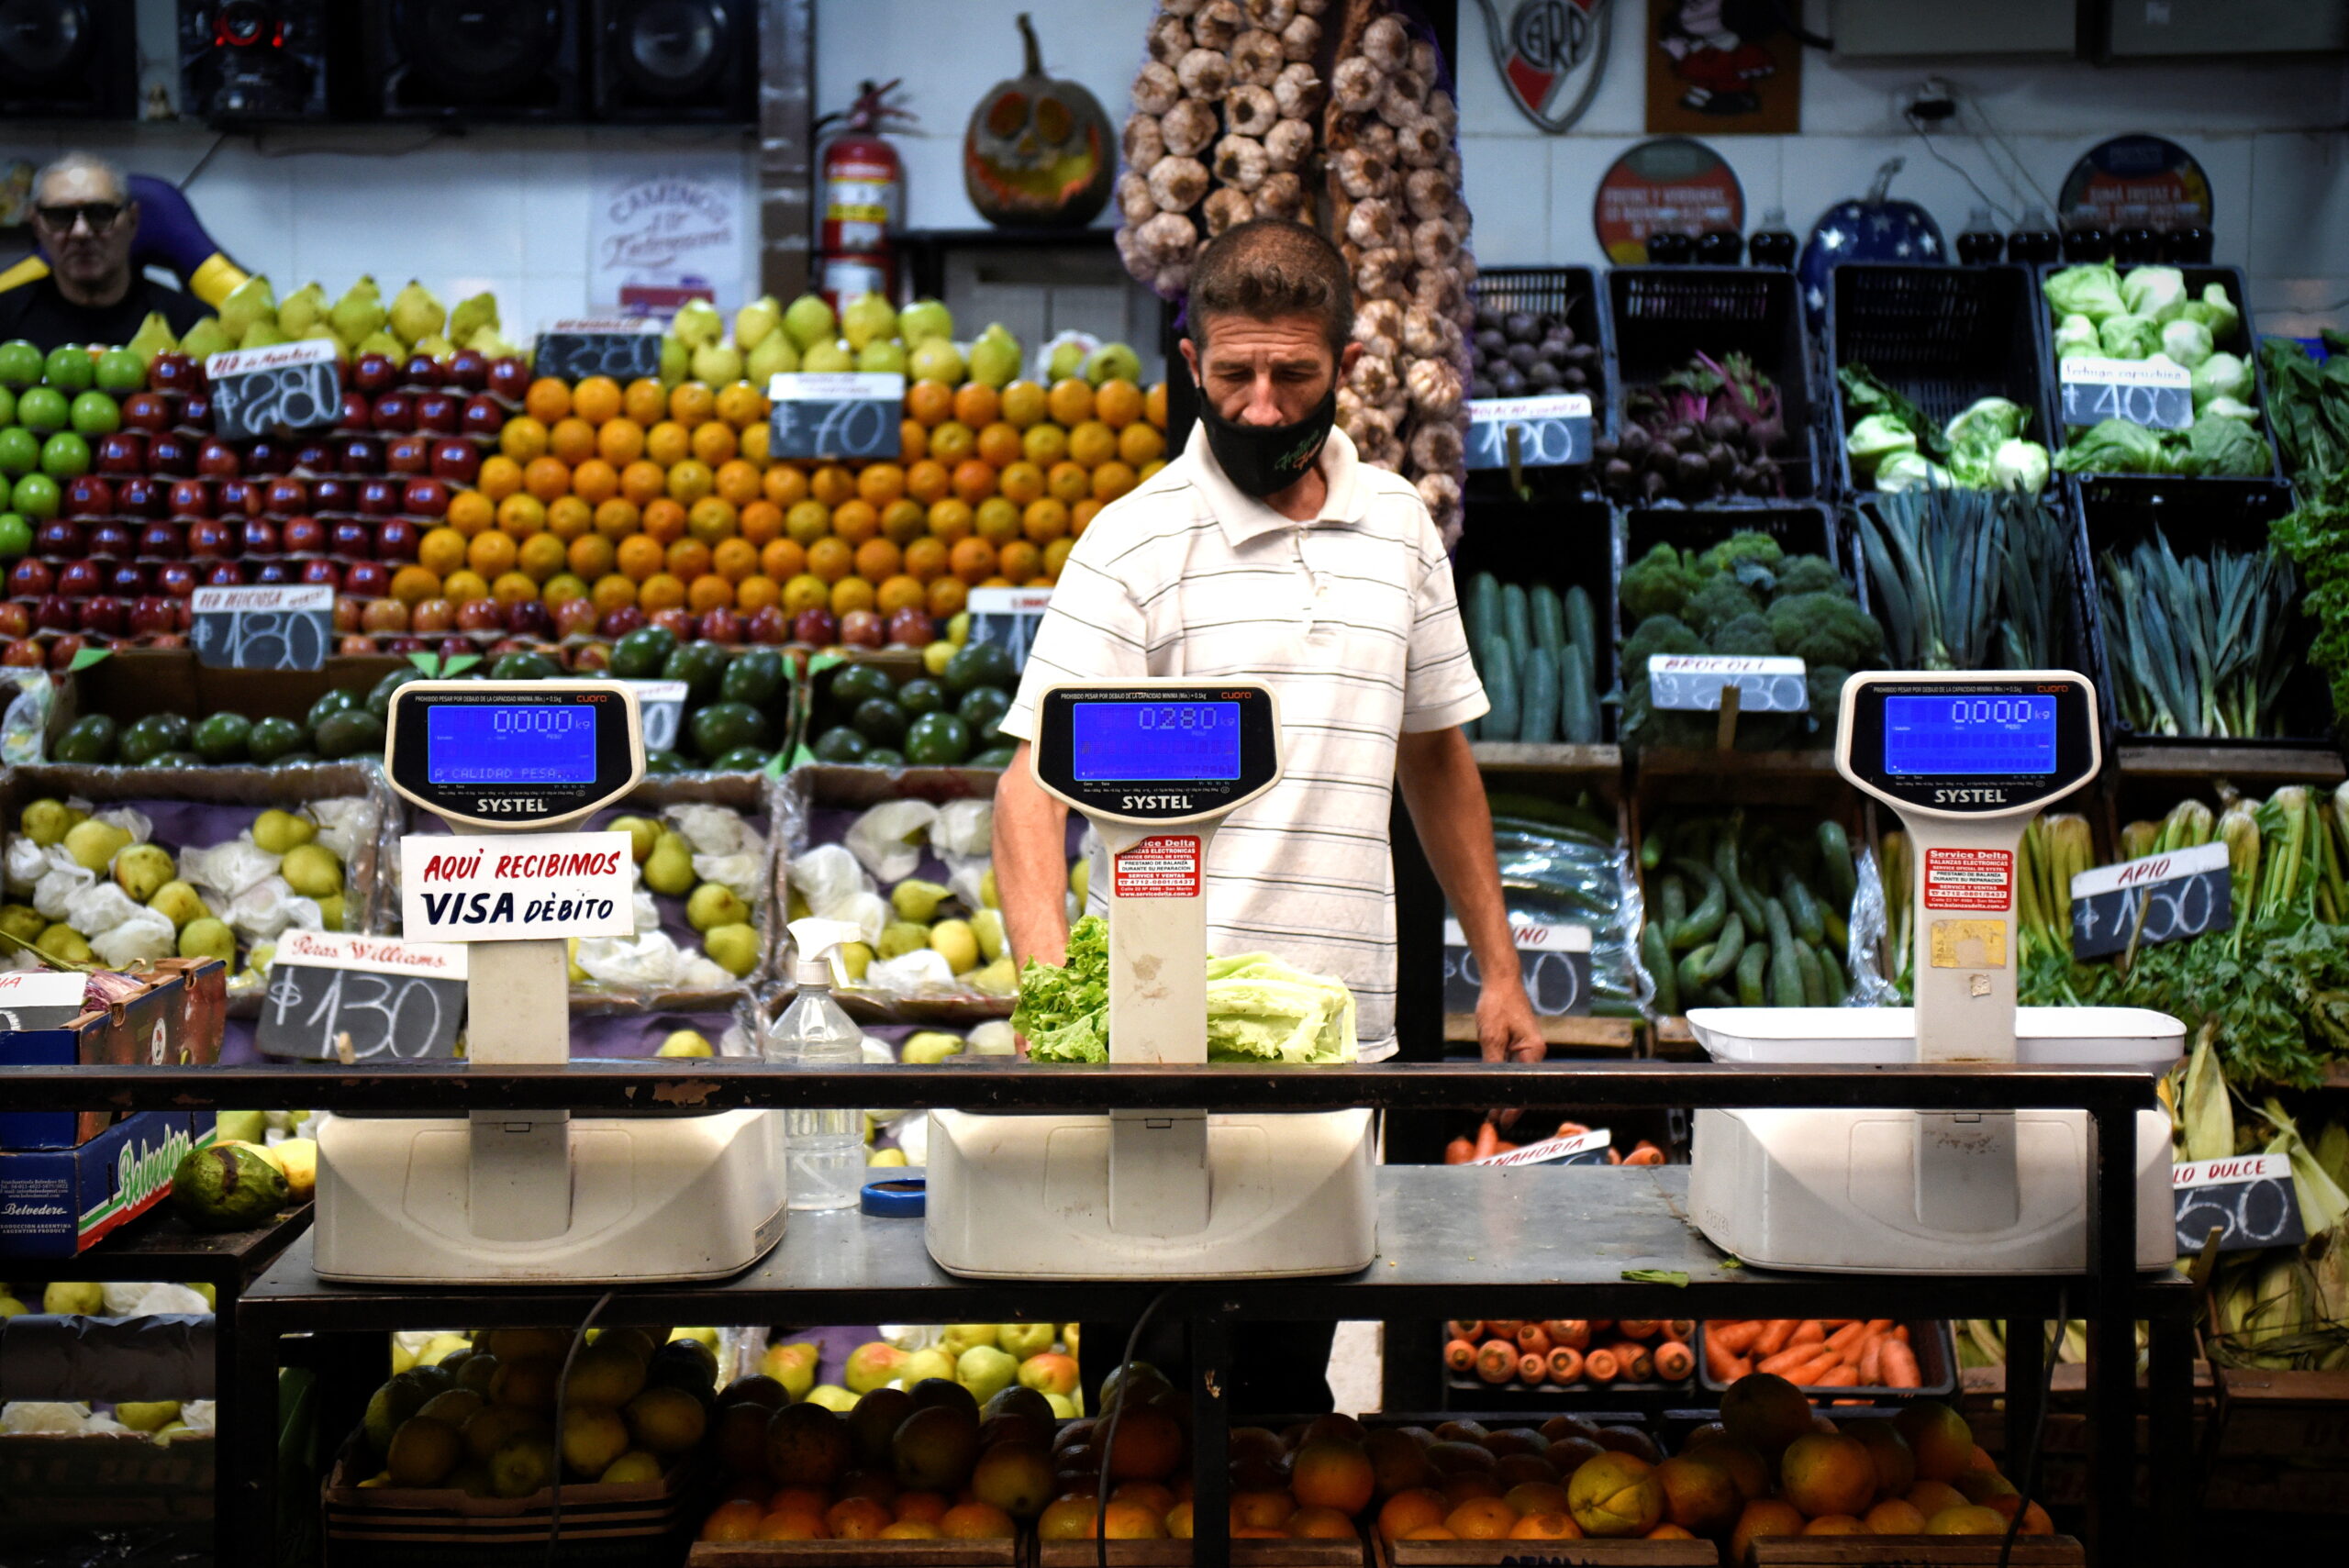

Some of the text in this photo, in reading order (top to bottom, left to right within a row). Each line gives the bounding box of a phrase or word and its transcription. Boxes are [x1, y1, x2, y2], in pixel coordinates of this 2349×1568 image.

[1121, 795, 1193, 810] SYSTEL
[1933, 789, 2008, 804] SYSTEL
[476, 798, 549, 813] SYSTEL
[1165, 839, 1196, 847] Delta
[1930, 850, 2009, 860] Service Delta
[495, 851, 621, 880] RECIBIMOS
[2118, 858, 2171, 886] APIO
[420, 892, 514, 926] VISA
[291, 935, 448, 969] Peras Williams
[2208, 1159, 2266, 1179] DULCE
[1, 1202, 68, 1216] Belvedere
